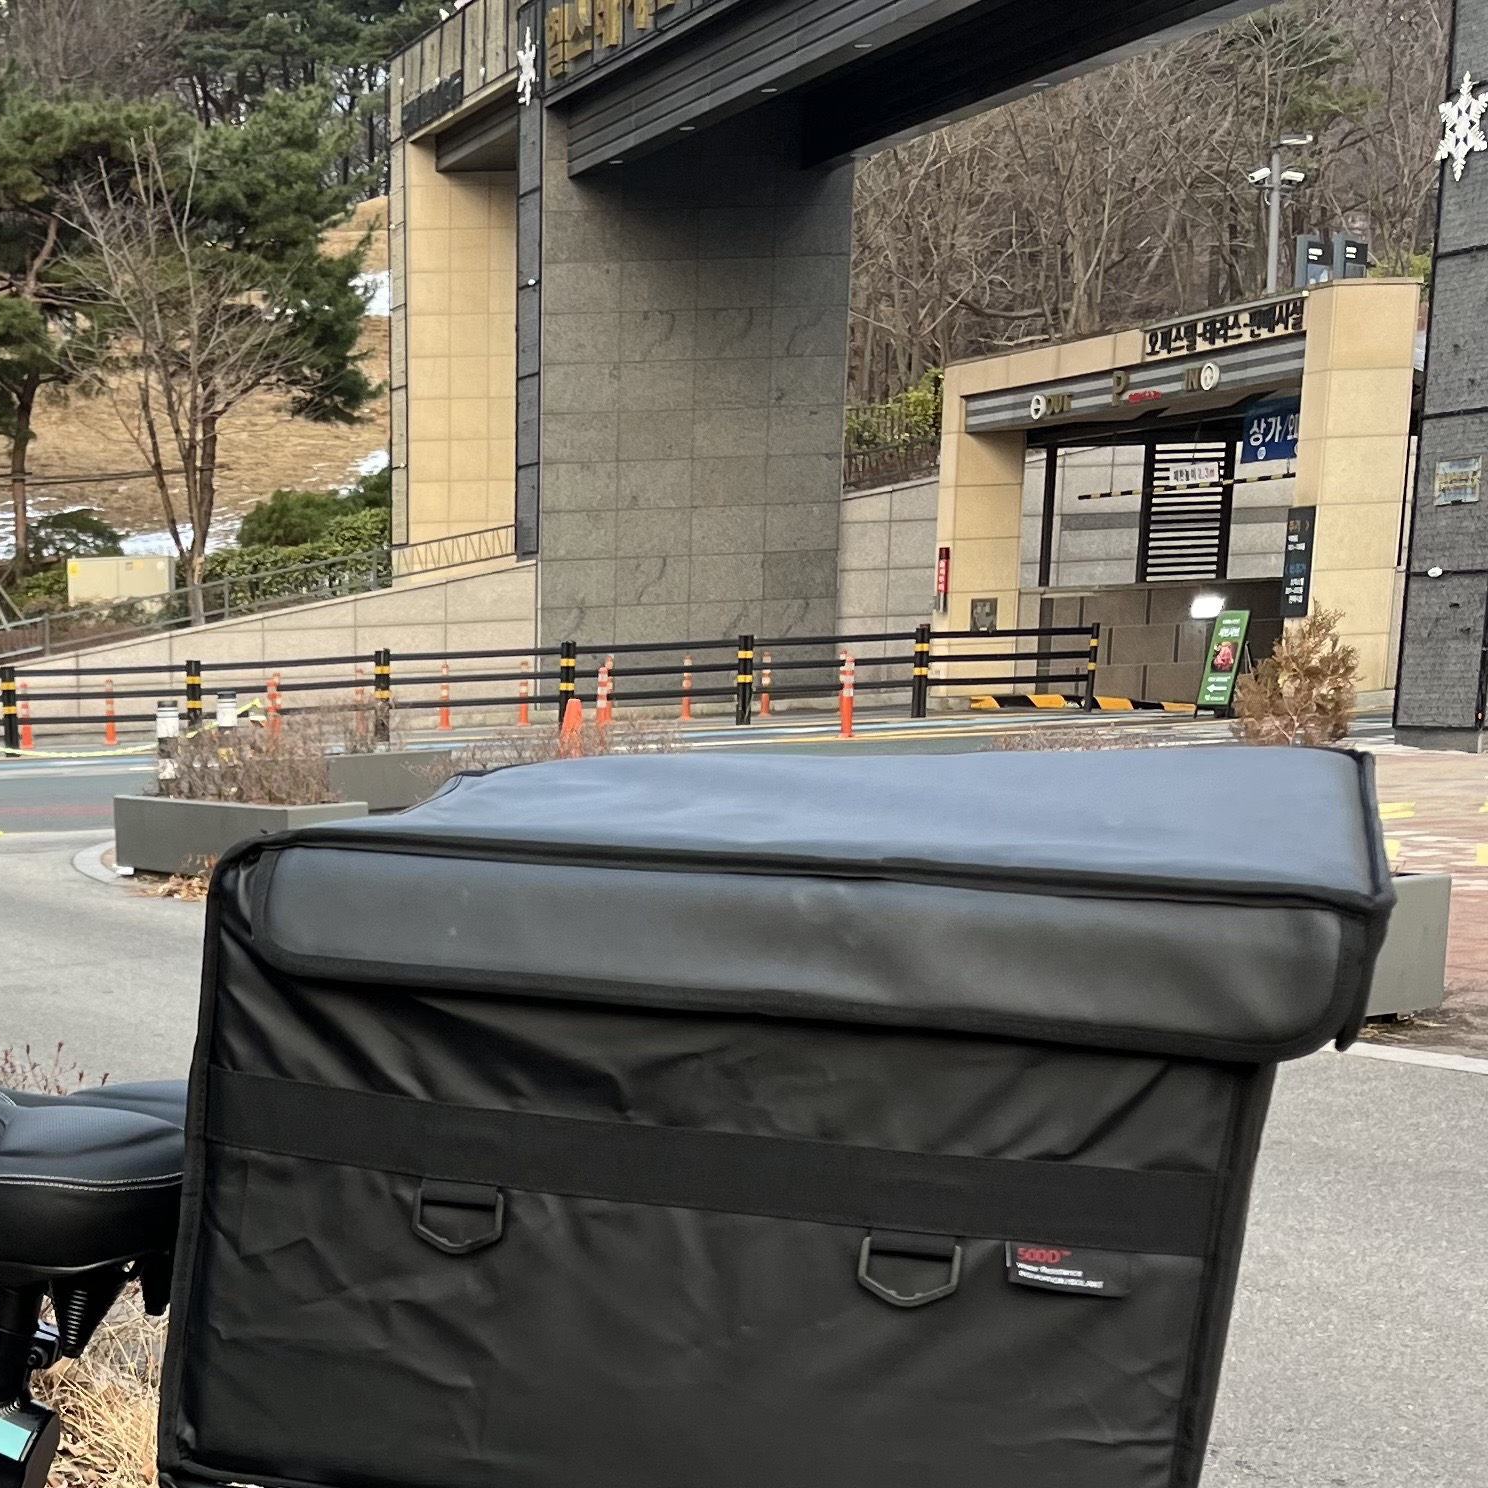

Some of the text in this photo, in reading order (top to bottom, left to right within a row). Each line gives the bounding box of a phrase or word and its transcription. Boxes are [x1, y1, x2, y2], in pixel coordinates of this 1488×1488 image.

[1112, 371, 1130, 407] P
[1184, 367, 1202, 392] IN
[1046, 392, 1073, 416] OUT
